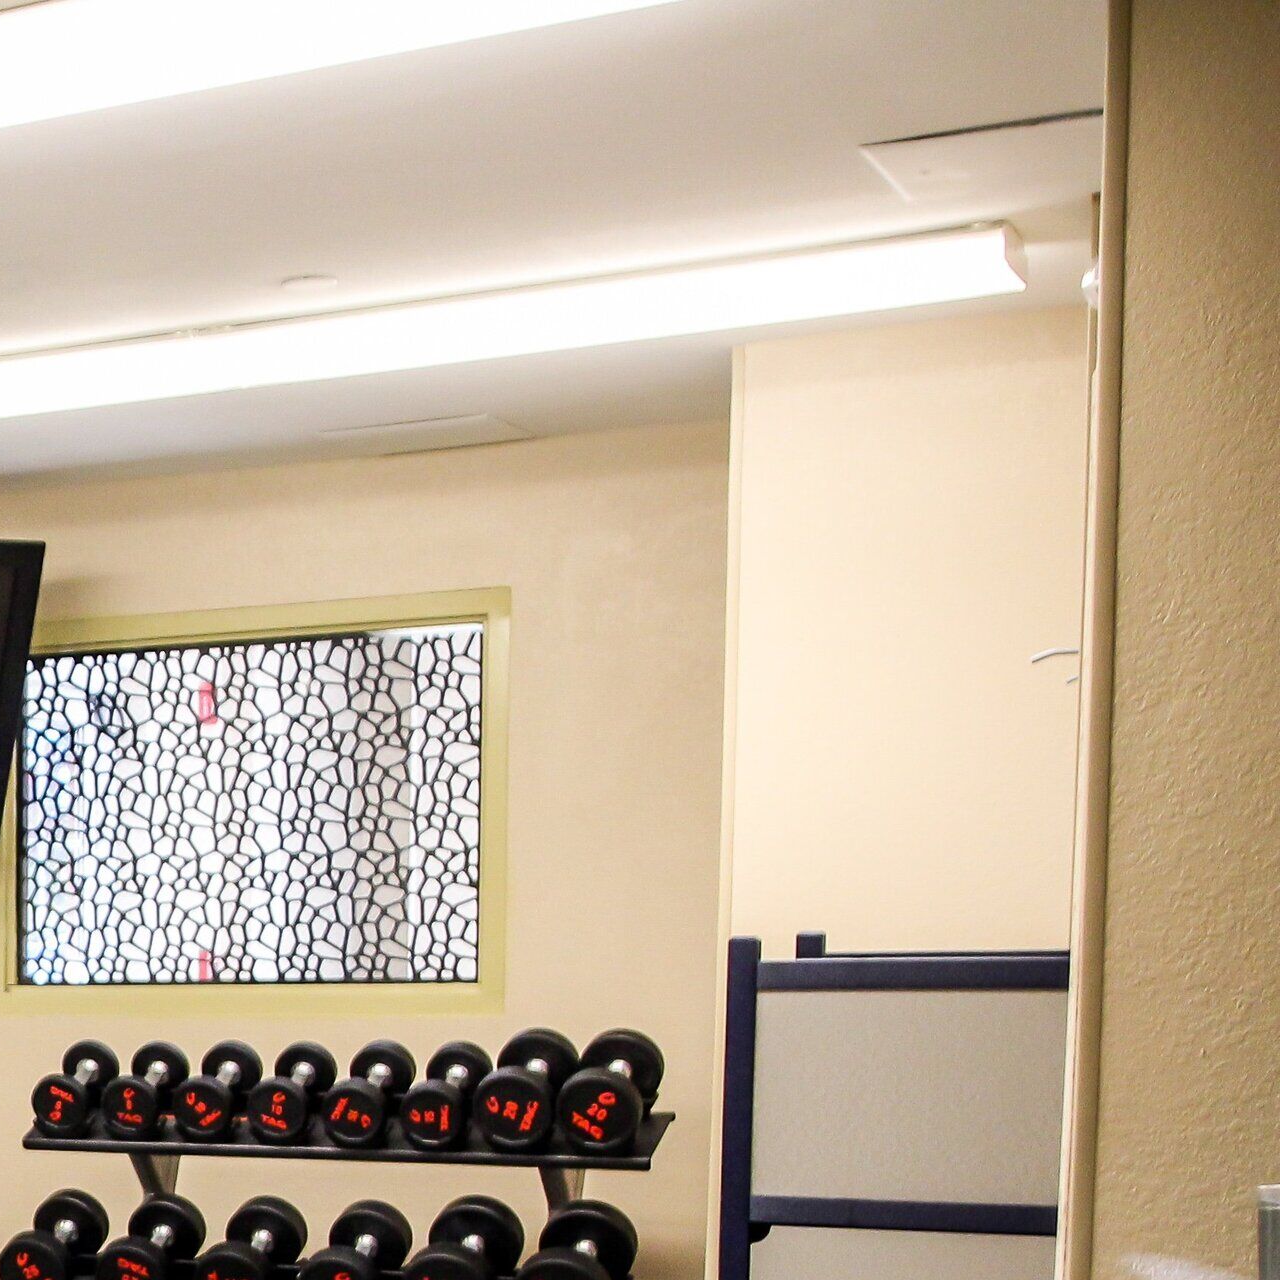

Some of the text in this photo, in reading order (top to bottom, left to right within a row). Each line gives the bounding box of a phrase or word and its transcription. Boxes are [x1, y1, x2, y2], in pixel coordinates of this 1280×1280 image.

[502, 1100, 519, 1120] 20
[586, 1102, 608, 1122] 20
[571, 1111, 604, 1140] TAG
